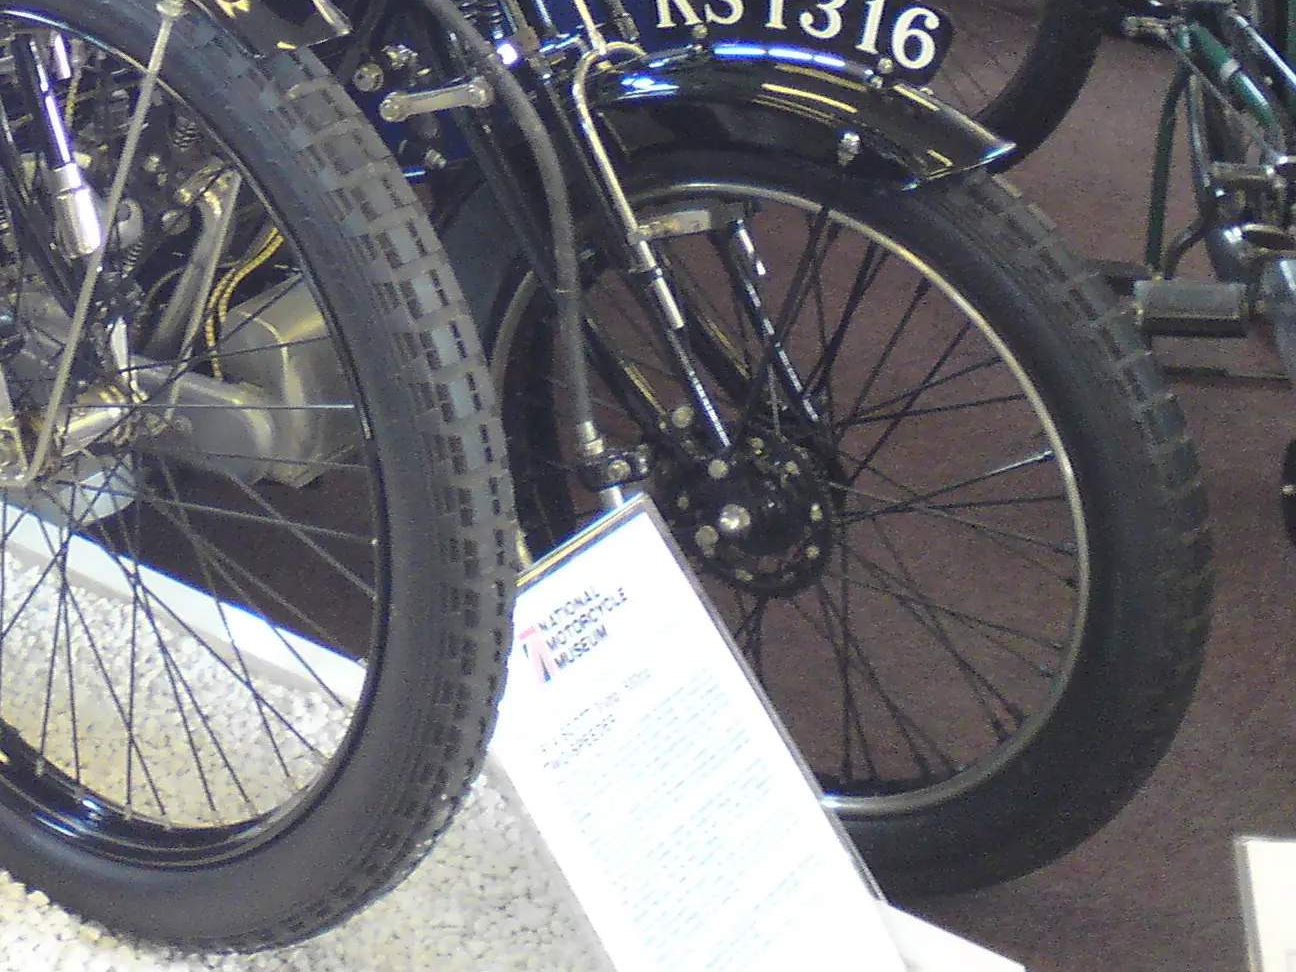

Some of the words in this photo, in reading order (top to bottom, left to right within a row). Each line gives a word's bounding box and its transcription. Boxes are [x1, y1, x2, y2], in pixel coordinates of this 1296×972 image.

[539, 587, 601, 631] NATIONAL
[546, 587, 628, 652] MOTORCYCLE
[554, 625, 608, 669] MUSEUM
